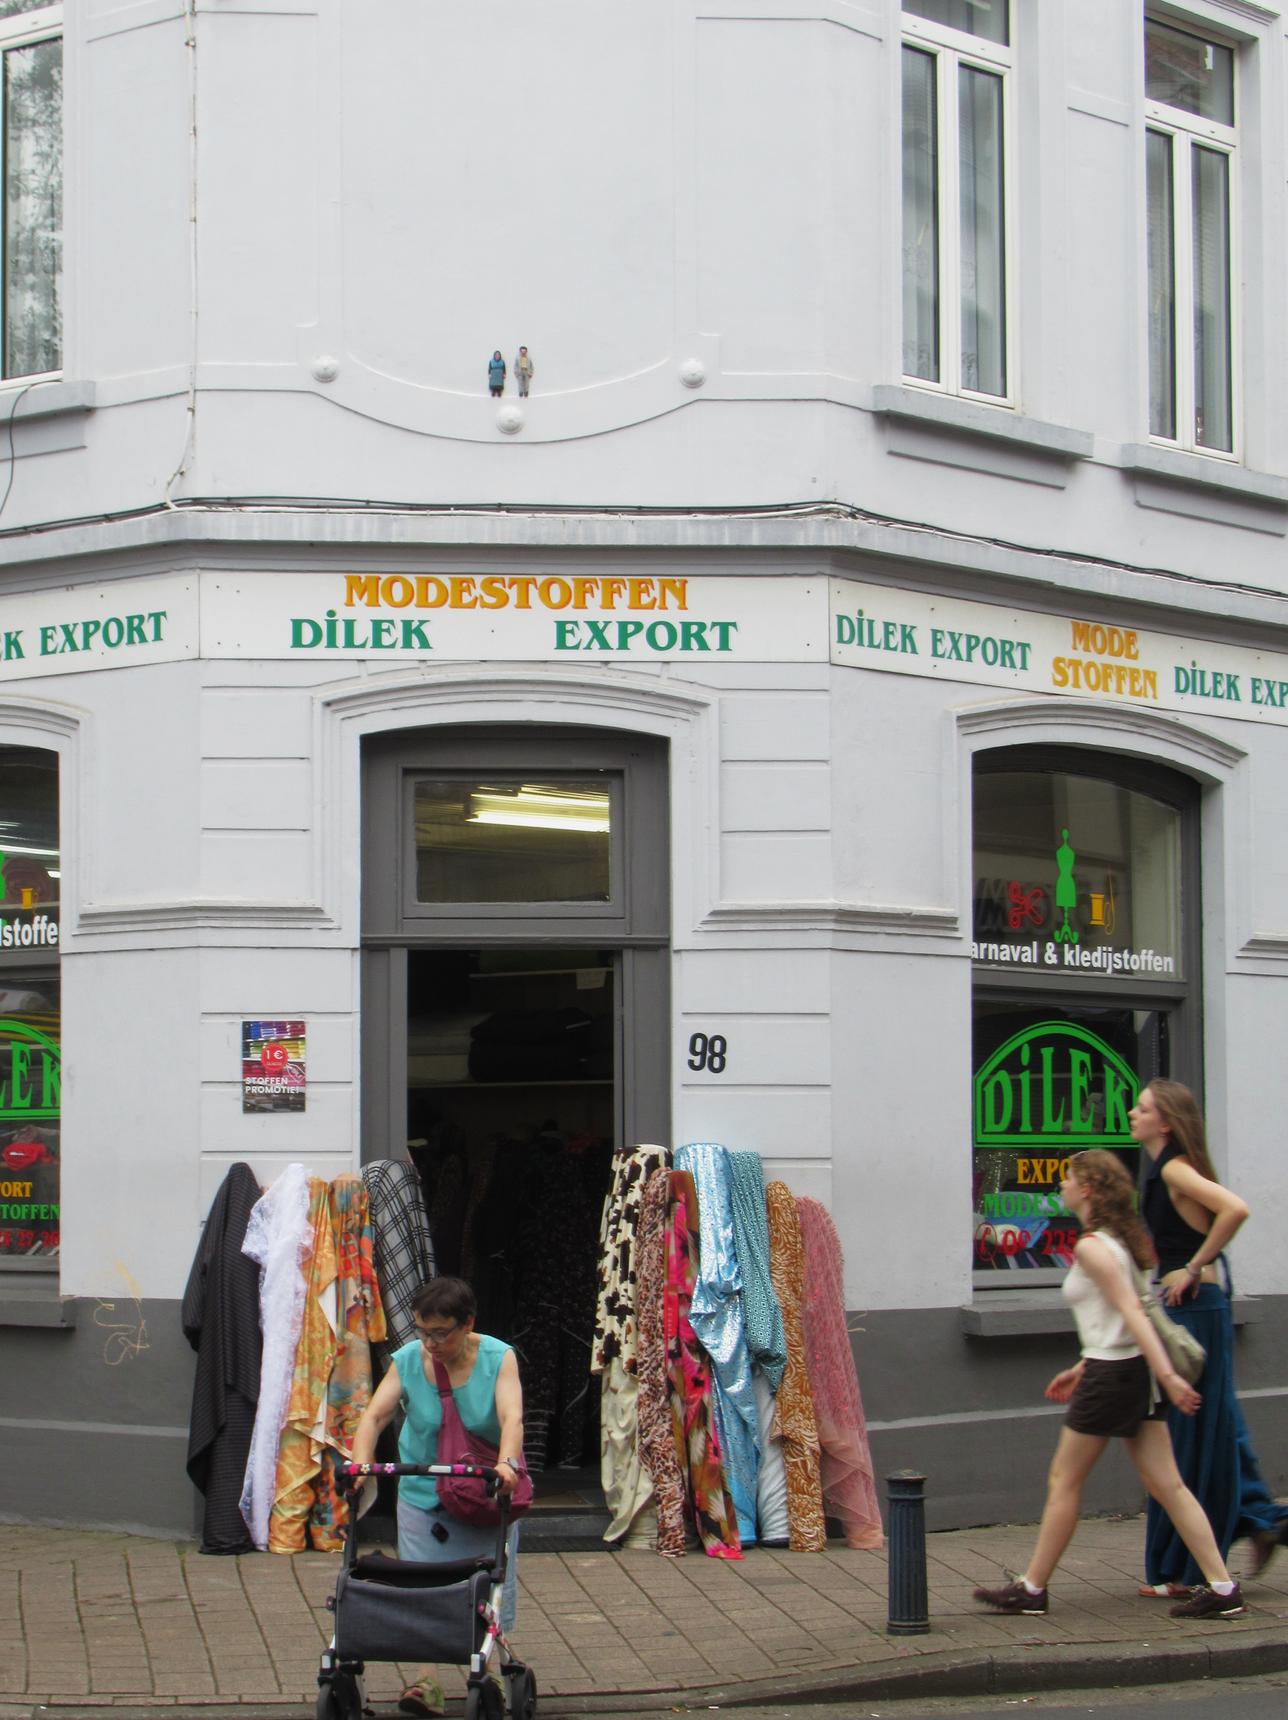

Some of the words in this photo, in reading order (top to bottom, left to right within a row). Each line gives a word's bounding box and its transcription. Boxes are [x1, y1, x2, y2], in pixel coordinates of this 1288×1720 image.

[344, 574, 688, 610] MODESTOFFEN
[0, 630, 25, 661] K
[40, 611, 167, 656] EXPORT
[554, 620, 738, 651] EXPORT
[931, 628, 1032, 671] EXPORT
[1071, 620, 1139, 661] MODE
[1052, 656, 1158, 700] STOFFEN
[1251, 677, 1288, 708] EXP
[1044, 942, 1058, 965] &
[1064, 944, 1174, 974] kledijstoffen
[688, 1032, 727, 1074] 98
[0, 1041, 61, 1108] EK
[245, 1077, 288, 1085] STOFFEN
[0, 1181, 33, 1198] ORT
